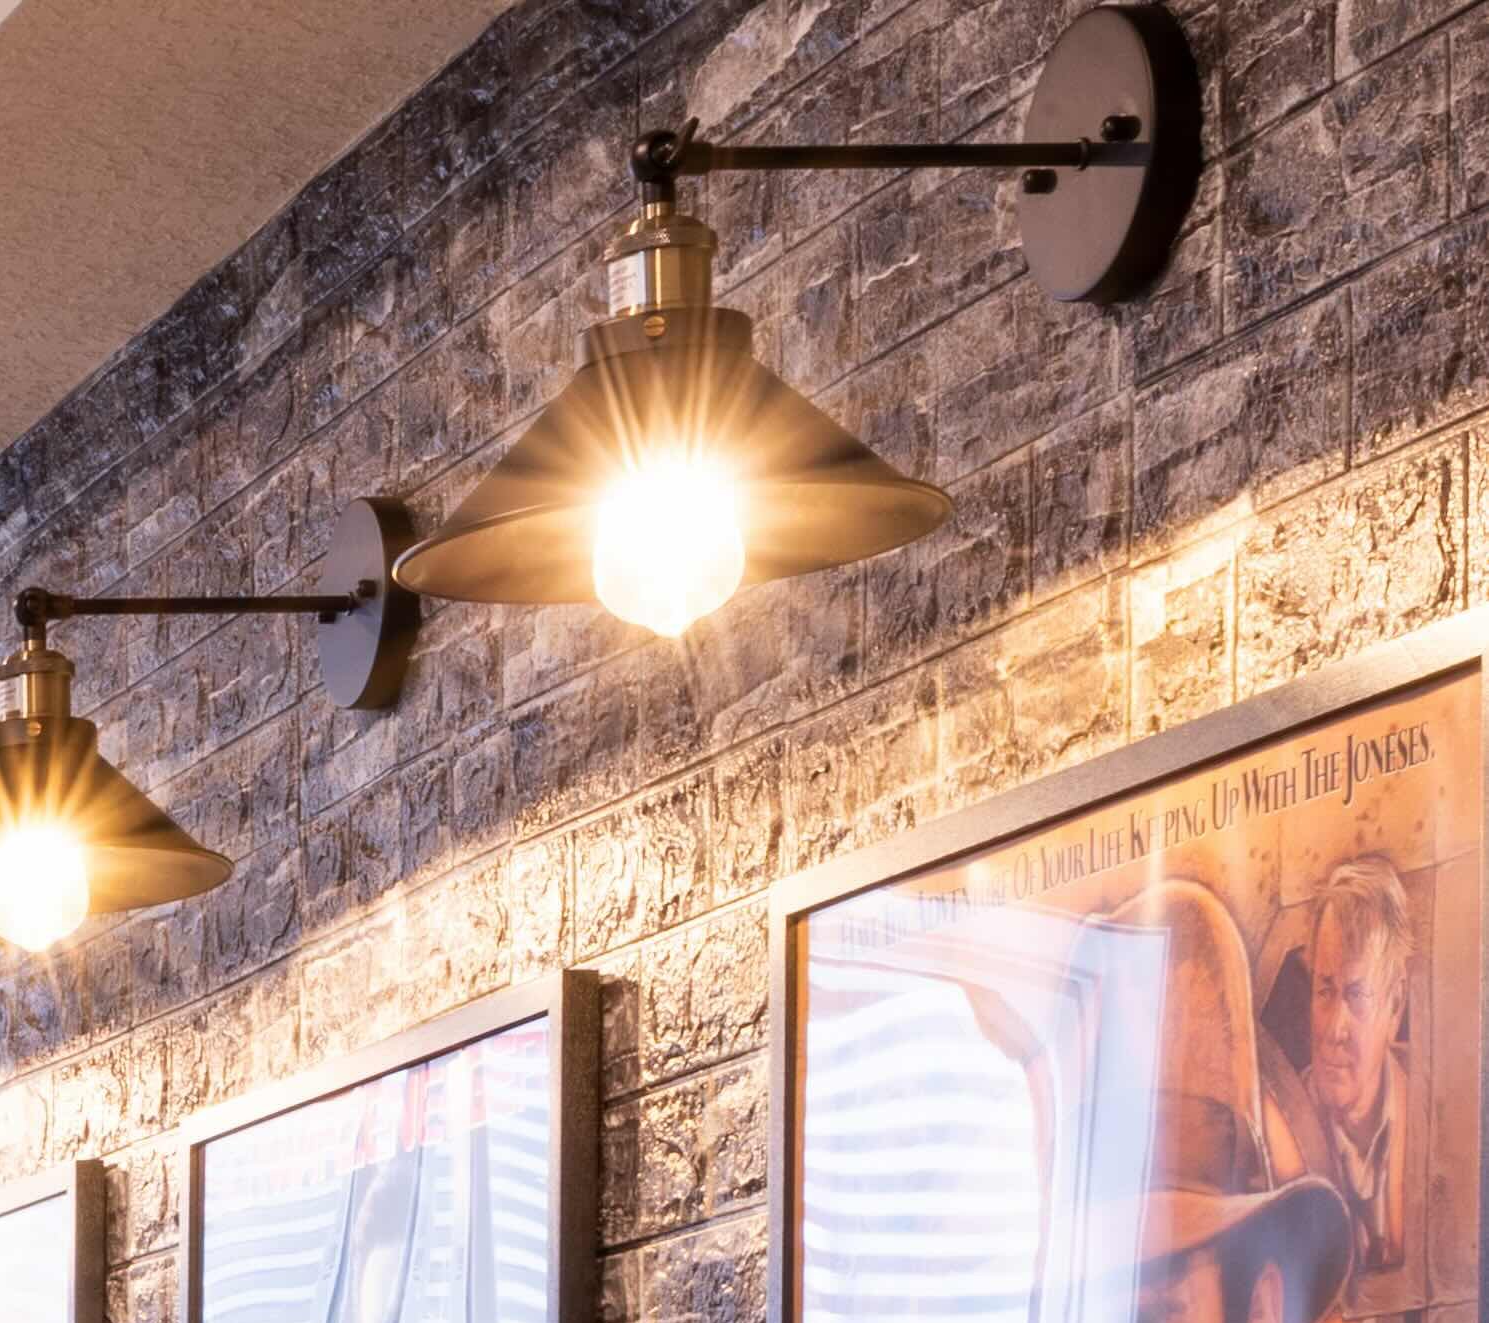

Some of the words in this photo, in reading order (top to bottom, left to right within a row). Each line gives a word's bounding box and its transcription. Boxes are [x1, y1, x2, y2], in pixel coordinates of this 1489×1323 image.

[1090, 827, 1124, 873] LIFE
[1212, 779, 1239, 830] UP
[1242, 765, 1296, 818] WITH
[1302, 747, 1341, 801] THE
[1343, 721, 1435, 806] JONESES.
